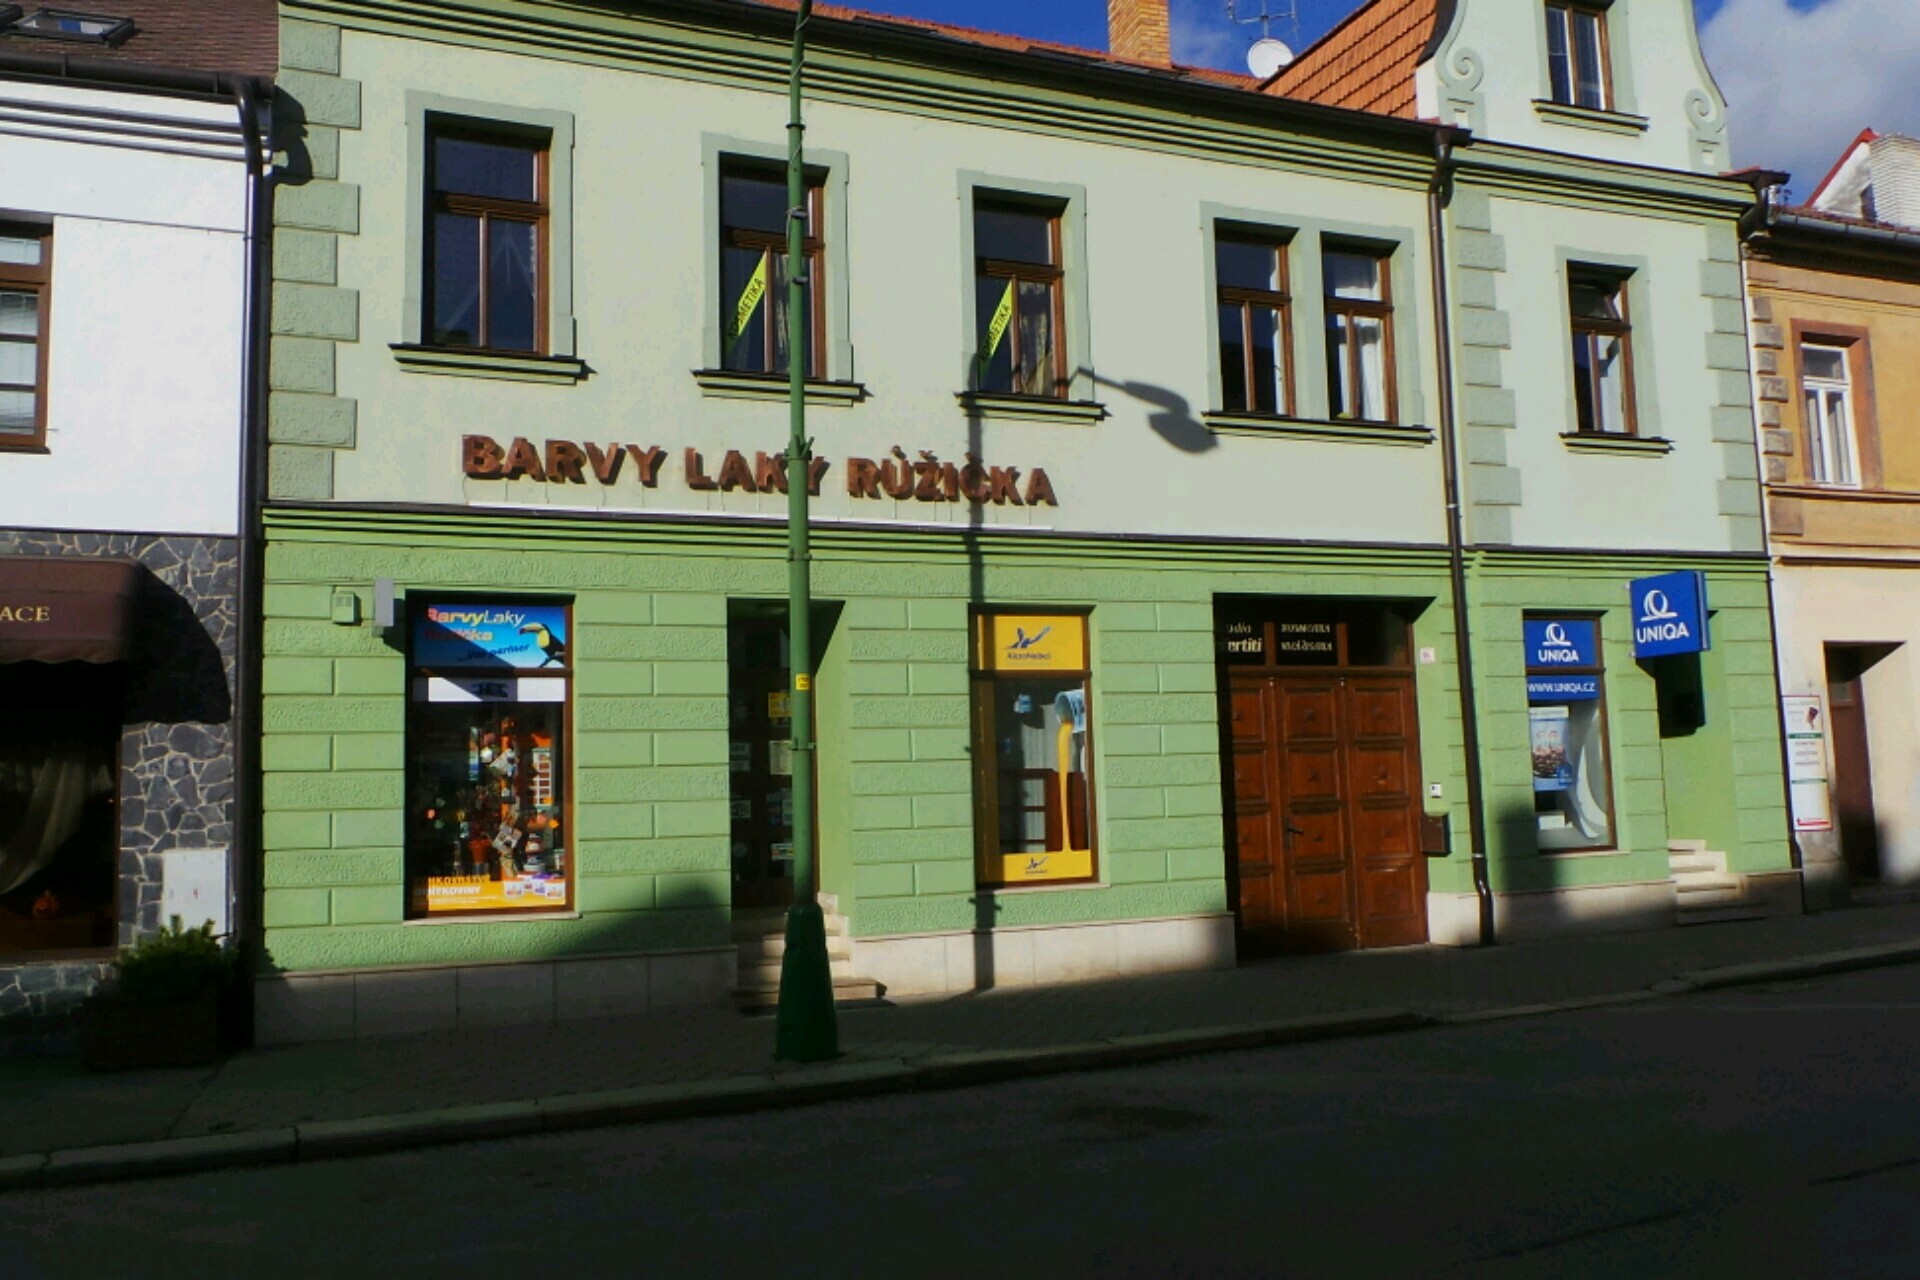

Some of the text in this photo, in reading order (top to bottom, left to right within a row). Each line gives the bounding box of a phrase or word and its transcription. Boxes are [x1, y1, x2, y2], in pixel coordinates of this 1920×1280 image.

[462, 433, 668, 488] BARVY
[847, 445, 1058, 506] RŮŽIČKA
[1636, 622, 1690, 643] UNIQA
[1538, 649, 1579, 662] UNIQA
